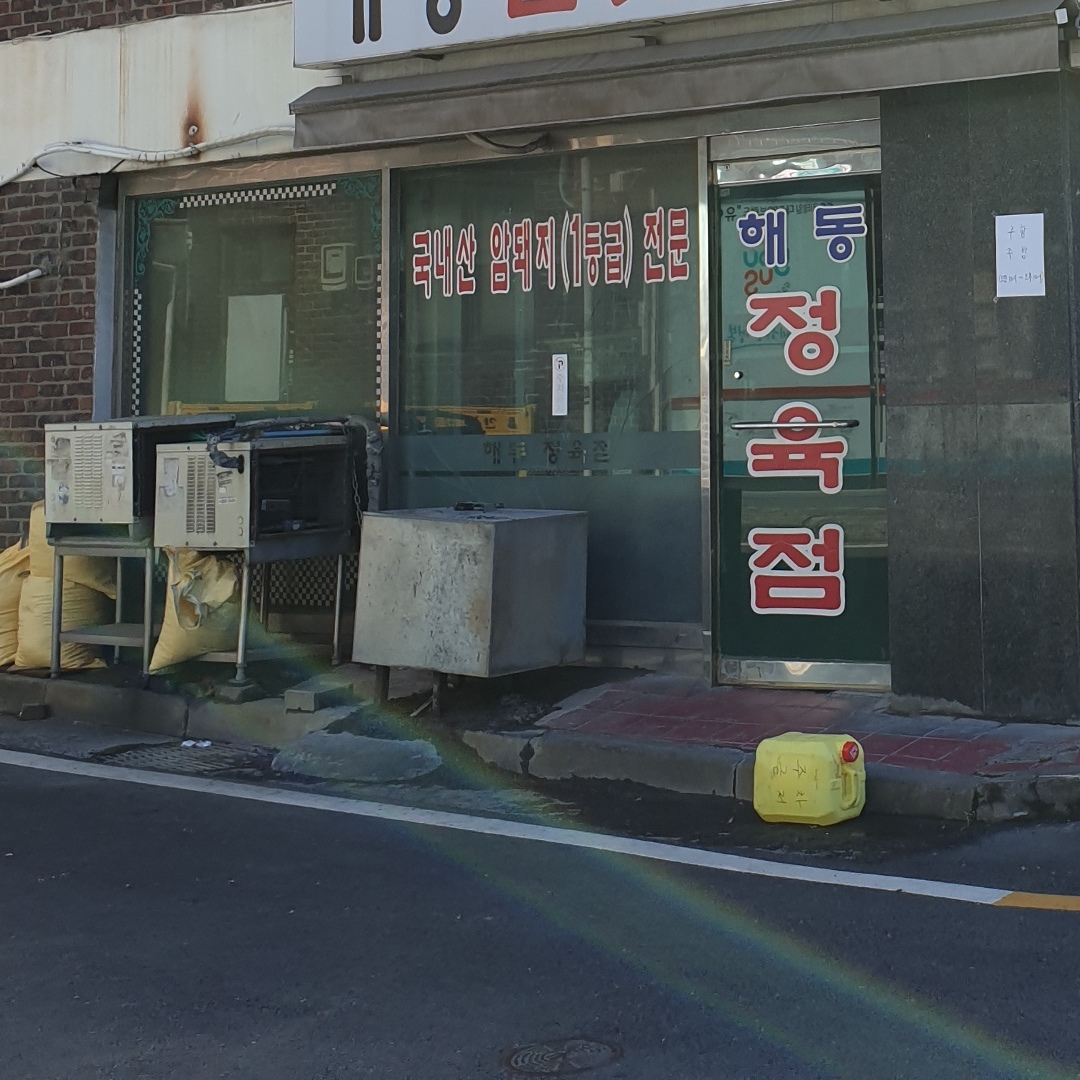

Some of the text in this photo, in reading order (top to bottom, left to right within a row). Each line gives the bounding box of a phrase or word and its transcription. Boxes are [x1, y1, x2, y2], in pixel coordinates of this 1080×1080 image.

[412, 223, 477, 300] 국내산
[643, 206, 690, 285] 전문
[738, 203, 868, 268] 해동
[745, 285, 848, 616] 정육점
